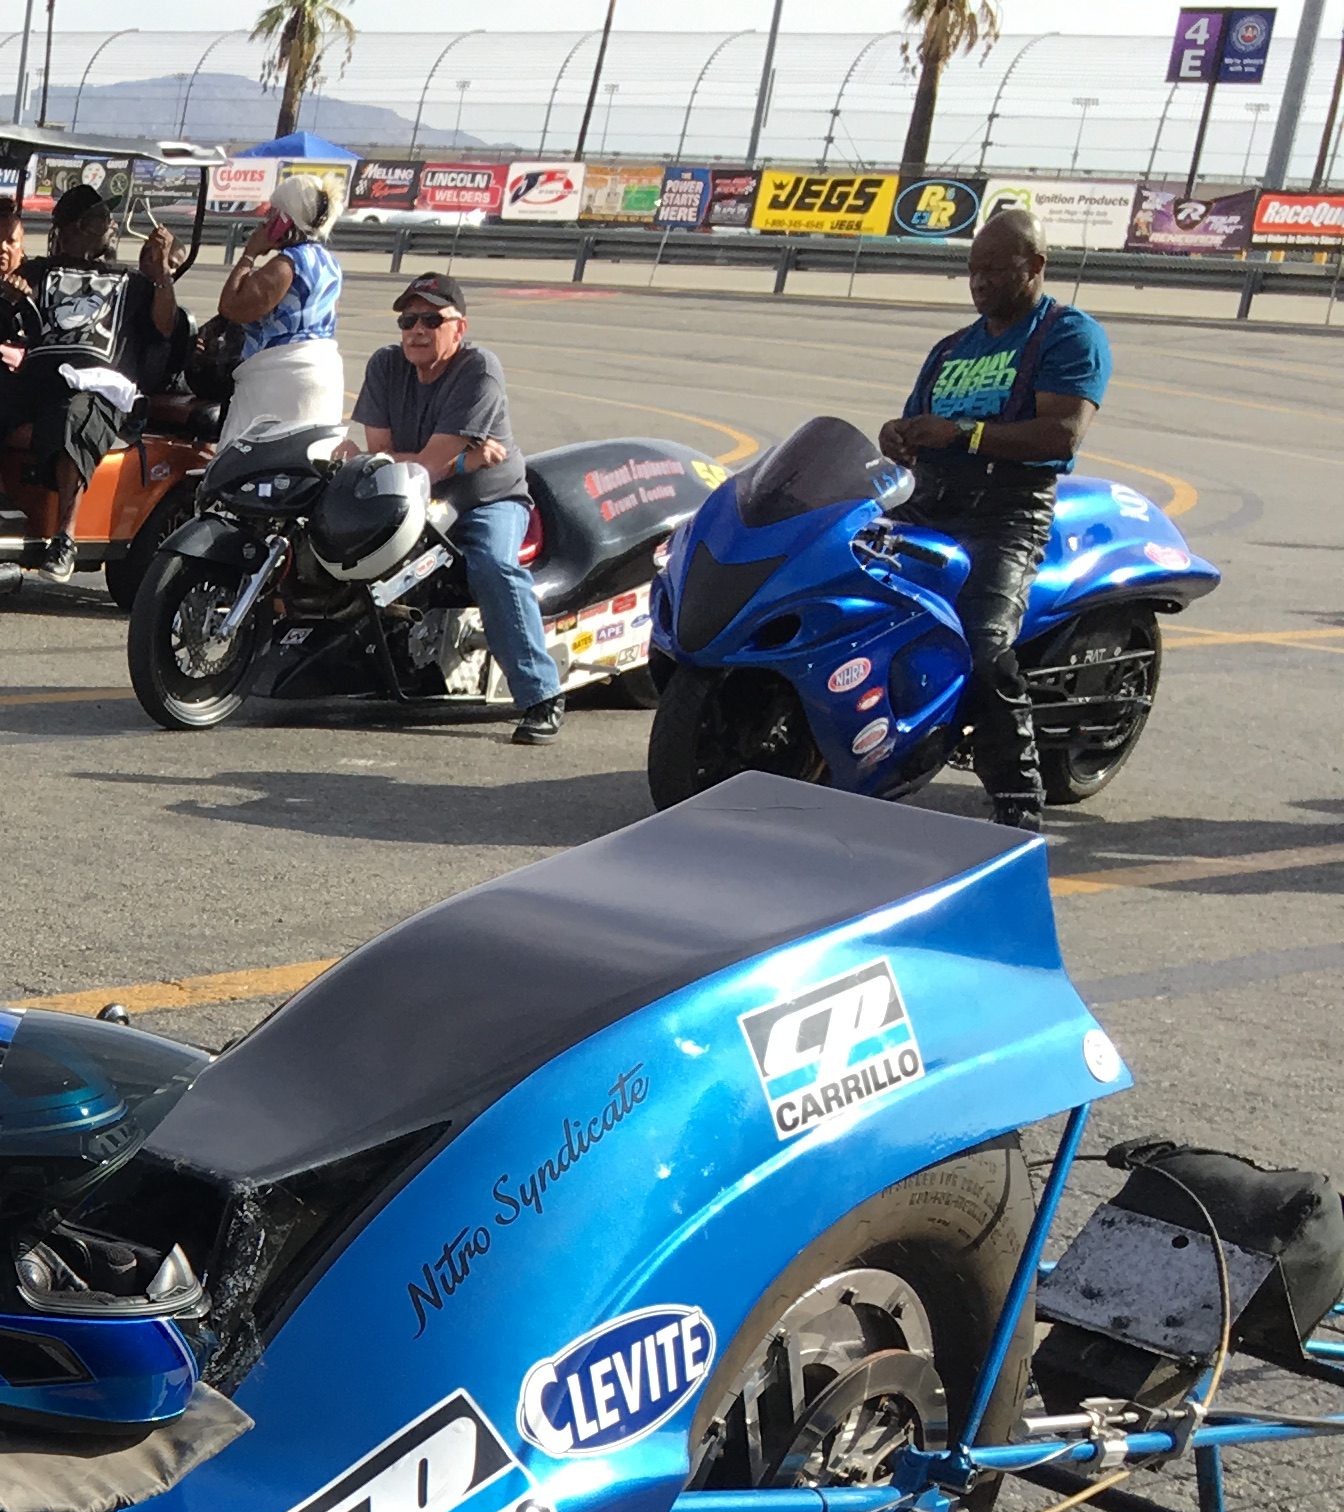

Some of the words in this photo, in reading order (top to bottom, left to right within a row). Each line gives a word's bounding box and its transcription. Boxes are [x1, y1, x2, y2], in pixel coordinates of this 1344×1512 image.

[1185, 17, 1209, 45] 4
[1179, 49, 1205, 77] E
[220, 169, 264, 183] CLOYES
[363, 163, 413, 180] MELLING
[425, 172, 488, 188] LINCOLN
[666, 179, 703, 194] POWER
[767, 176, 885, 214] JEGS
[435, 189, 490, 203] WELDERS
[662, 193, 700, 207] STARTS
[1035, 192, 1075, 206] Ignition
[1077, 194, 1129, 207] Products
[659, 206, 697, 222] HERE
[1262, 200, 1344, 227] RaceQu
[599, 625, 623, 640] APE
[835, 664, 864, 686] NHRA
[776, 1048, 920, 1133] CARRILLO
[407, 1226, 491, 1340] Nitro
[492, 1062, 650, 1226] Syndicate
[522, 1312, 706, 1454] CLEVITE
